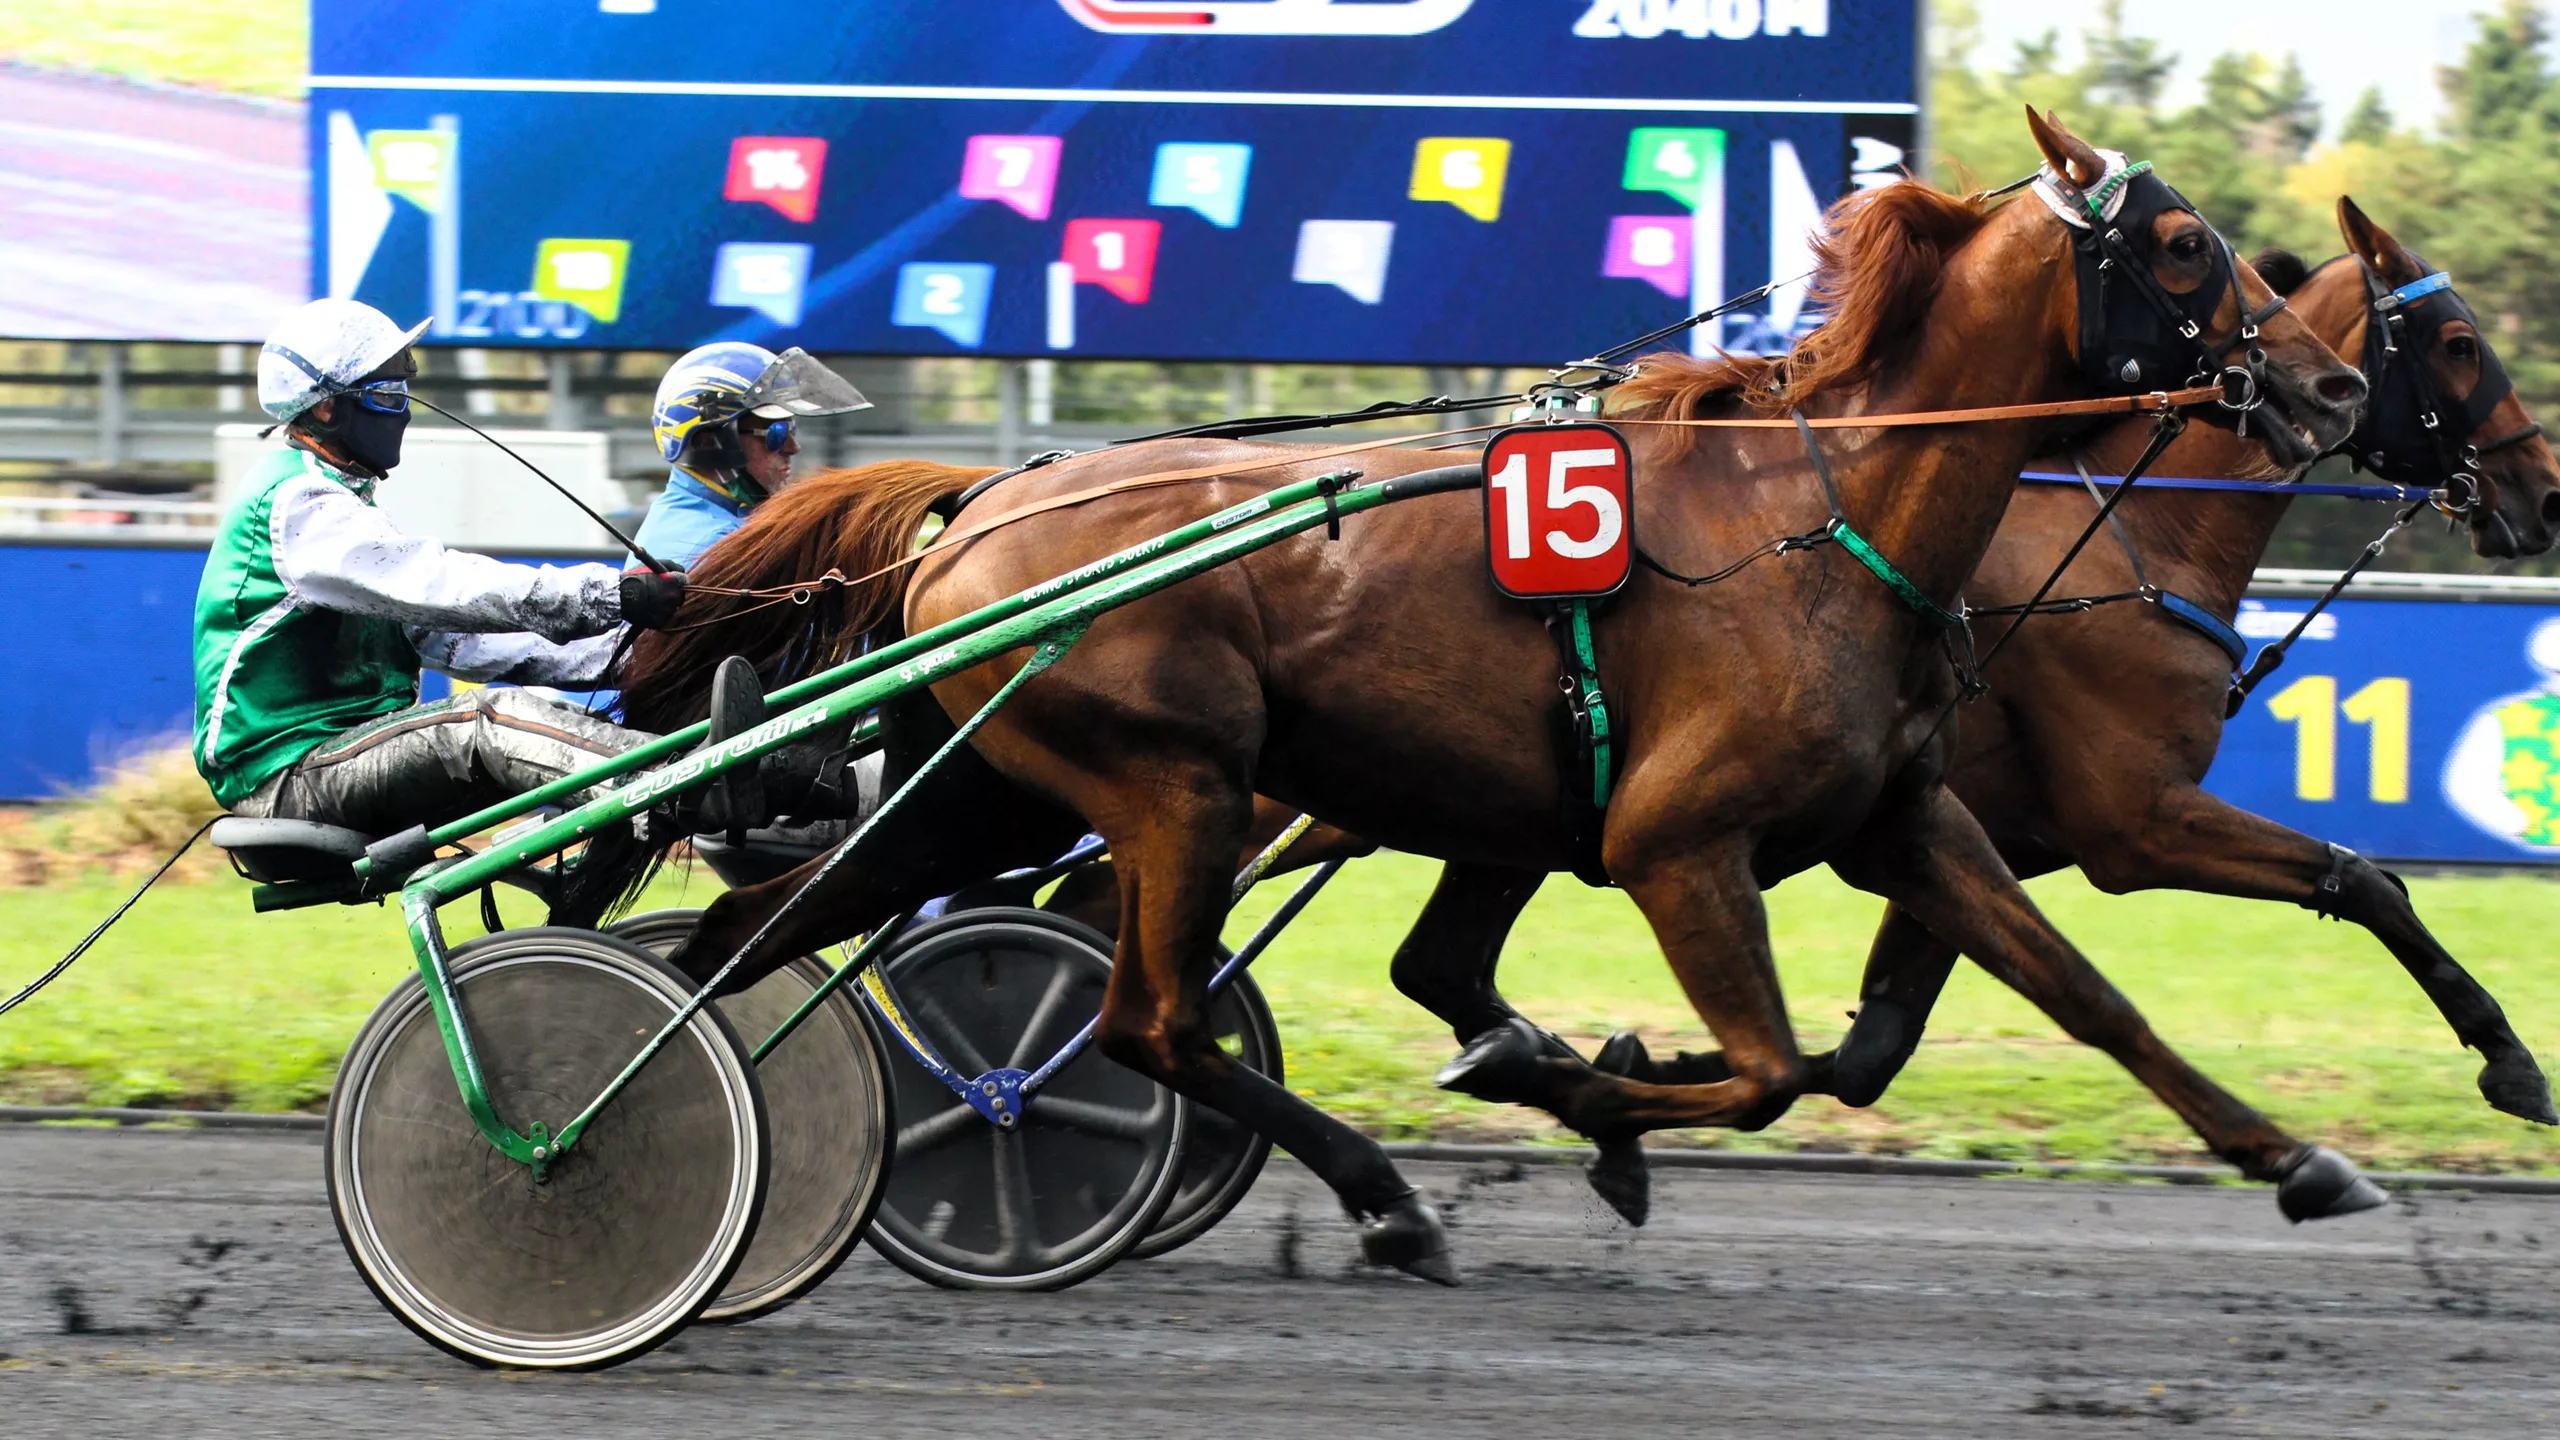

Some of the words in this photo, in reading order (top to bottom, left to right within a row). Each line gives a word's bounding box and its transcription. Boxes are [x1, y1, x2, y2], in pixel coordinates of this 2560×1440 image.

[991, 147, 1033, 188] 7
[1184, 155, 1222, 195] 5
[1440, 150, 1484, 190] 6
[1095, 232, 1126, 271] 1
[922, 273, 964, 315] 2
[1491, 448, 1623, 559] 15
[2266, 674, 2411, 803] 11
